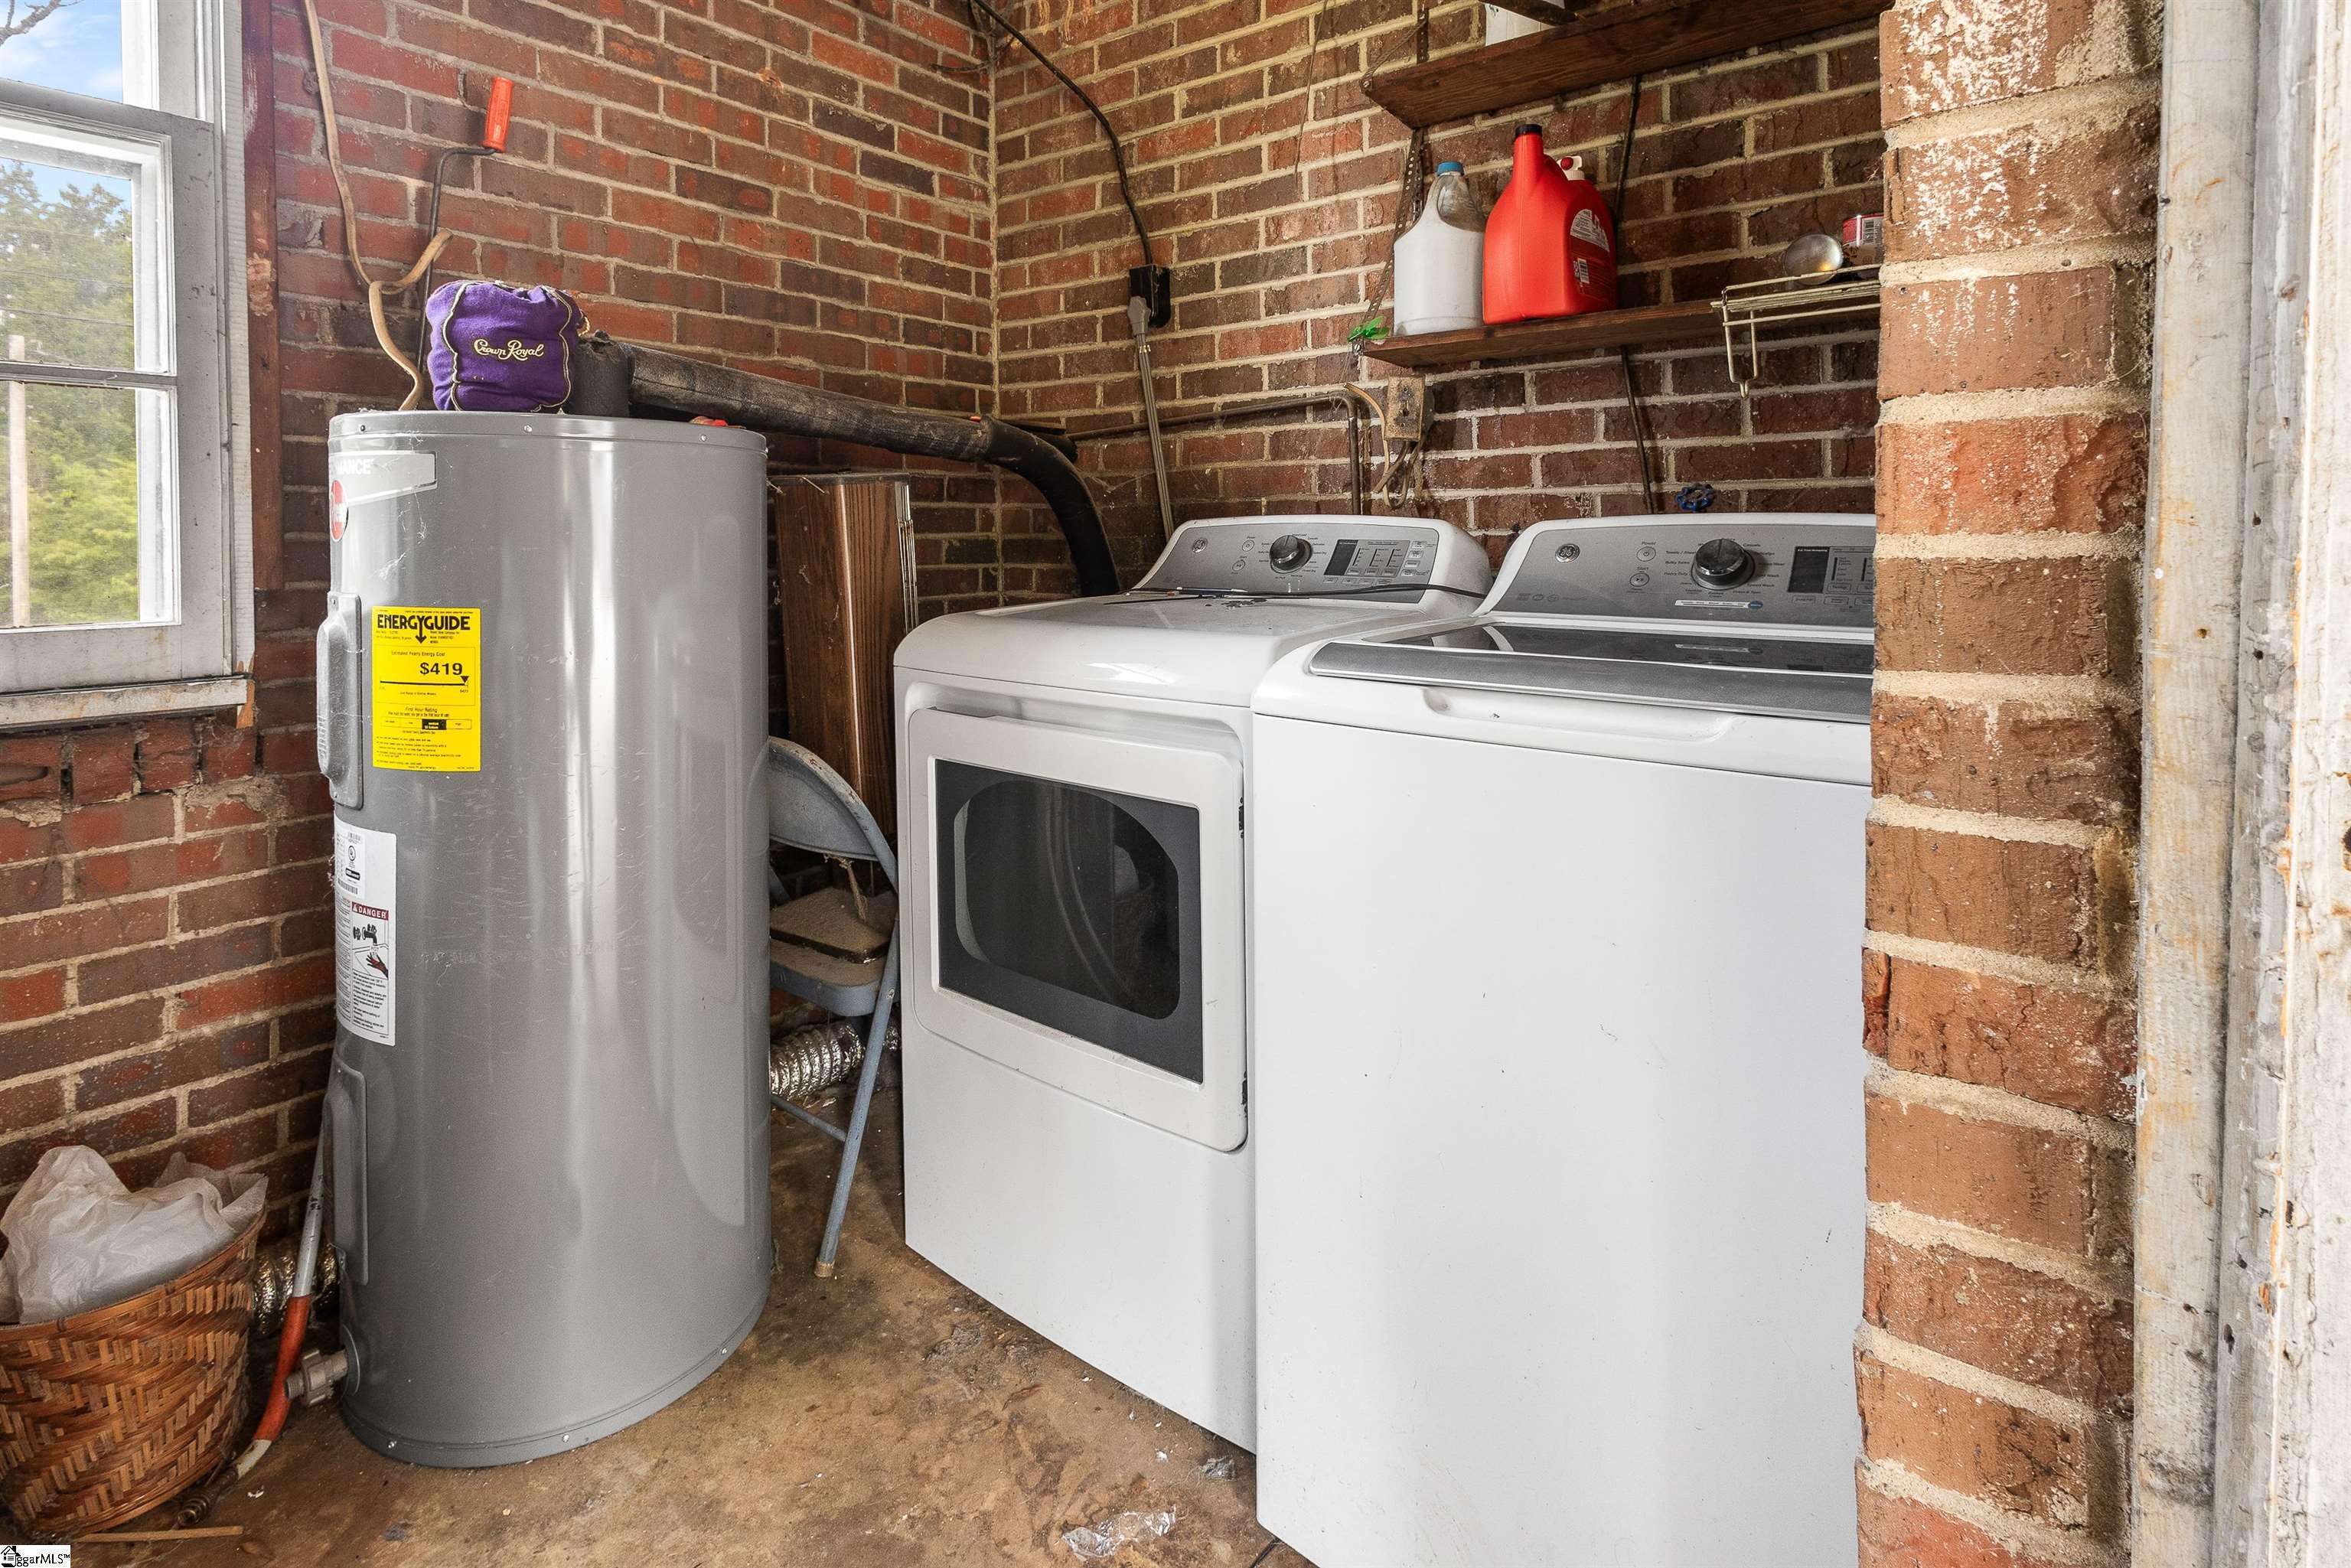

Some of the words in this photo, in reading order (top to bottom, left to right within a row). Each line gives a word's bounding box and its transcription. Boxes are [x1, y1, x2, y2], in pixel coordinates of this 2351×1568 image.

[474, 339, 508, 357] Crown
[501, 340, 544, 360] Royal
[419, 662, 463, 676] $419
[358, 906, 387, 919] DANGER
